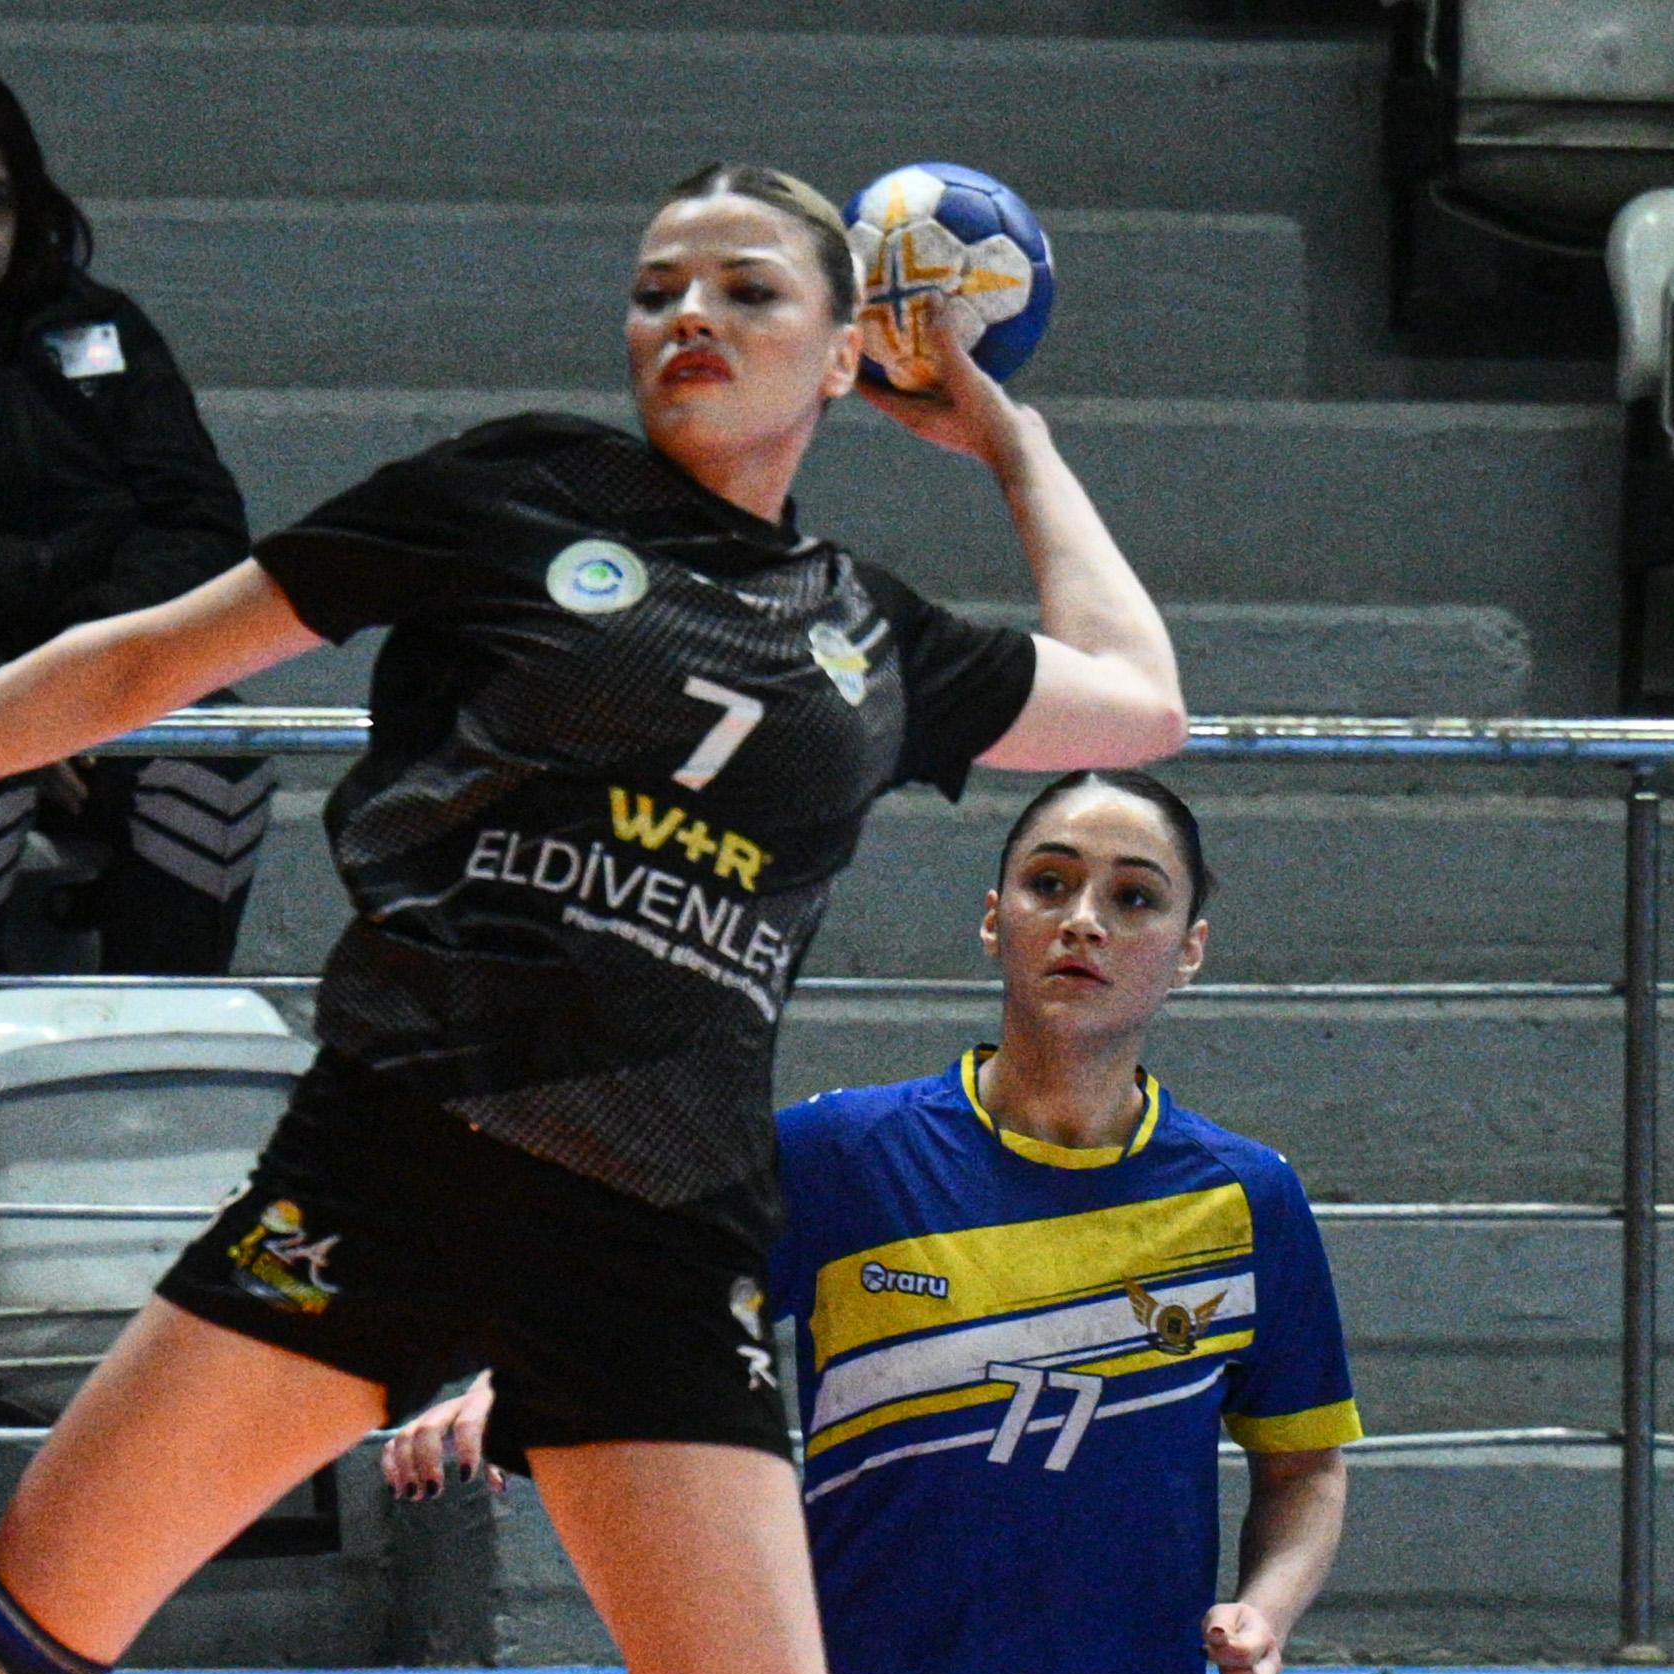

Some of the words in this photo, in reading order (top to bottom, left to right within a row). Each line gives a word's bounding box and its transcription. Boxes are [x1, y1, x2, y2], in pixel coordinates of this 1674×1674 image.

[672, 676, 764, 791] 7
[608, 785, 758, 893] W+R
[986, 1362, 1104, 1472] 77
